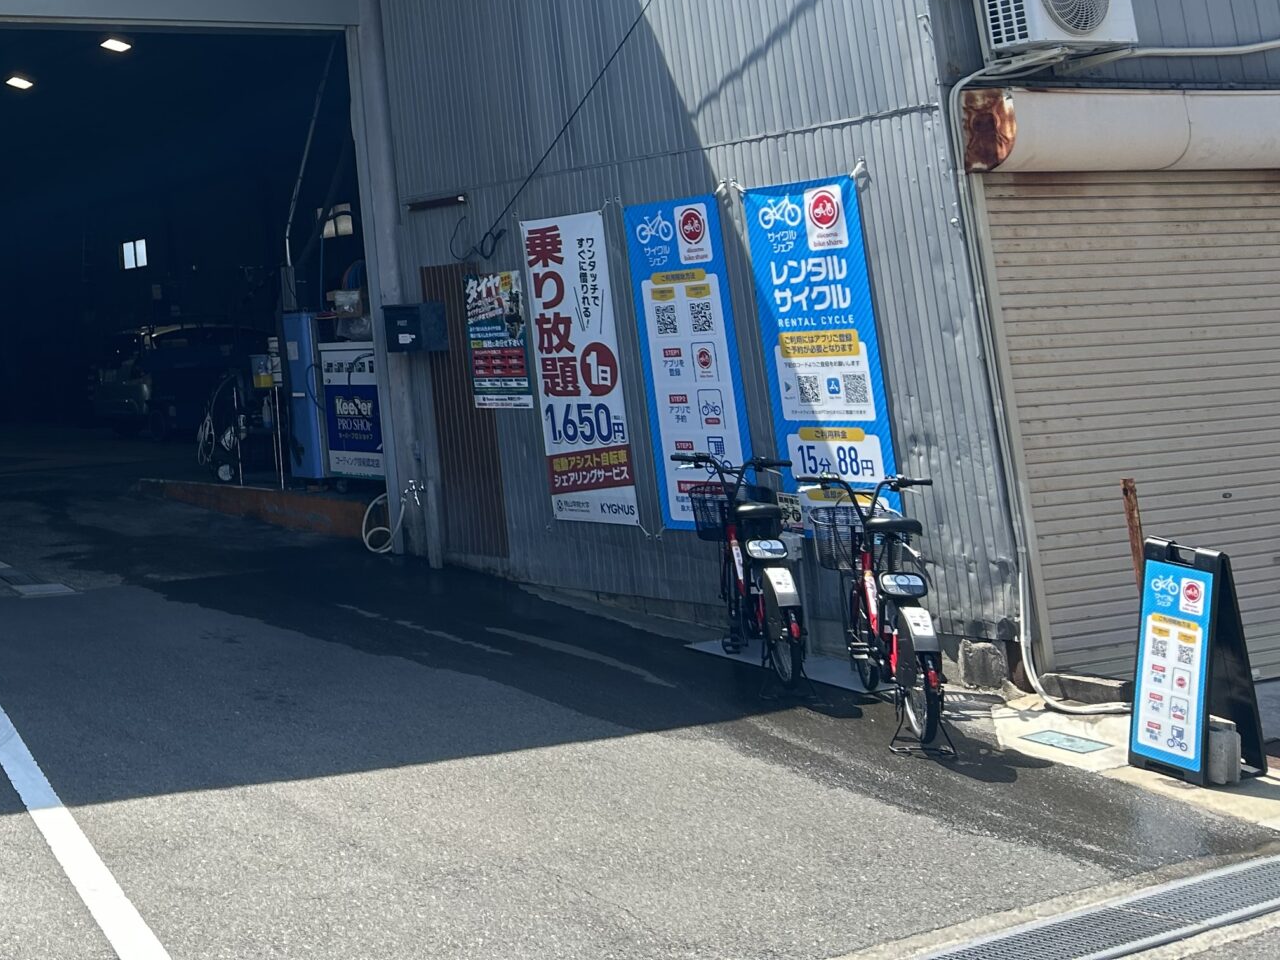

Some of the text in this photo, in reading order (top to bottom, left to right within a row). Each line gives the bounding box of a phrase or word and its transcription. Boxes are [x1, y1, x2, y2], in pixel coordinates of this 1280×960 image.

[767, 230, 797, 242] サイクル
[644, 245, 670, 257] サイクル
[773, 242, 794, 253] シェア
[585, 237, 600, 307] ワンタッチで
[649, 256, 668, 267] シェア
[770, 255, 847, 285] レンタル
[465, 273, 500, 304] タイヤ
[773, 284, 851, 313] サイクル
[525, 224, 581, 398] 乗り放題
[778, 314, 855, 328] RENTAL CYCLE
[337, 418, 353, 431] PRO
[545, 403, 626, 442] 1,650円
[552, 449, 628, 472] 電動アシスト自転車
[836, 445, 876, 477] 88円
[554, 466, 630, 488] シェアリングサービス
[600, 502, 635, 515] KYGNUS
